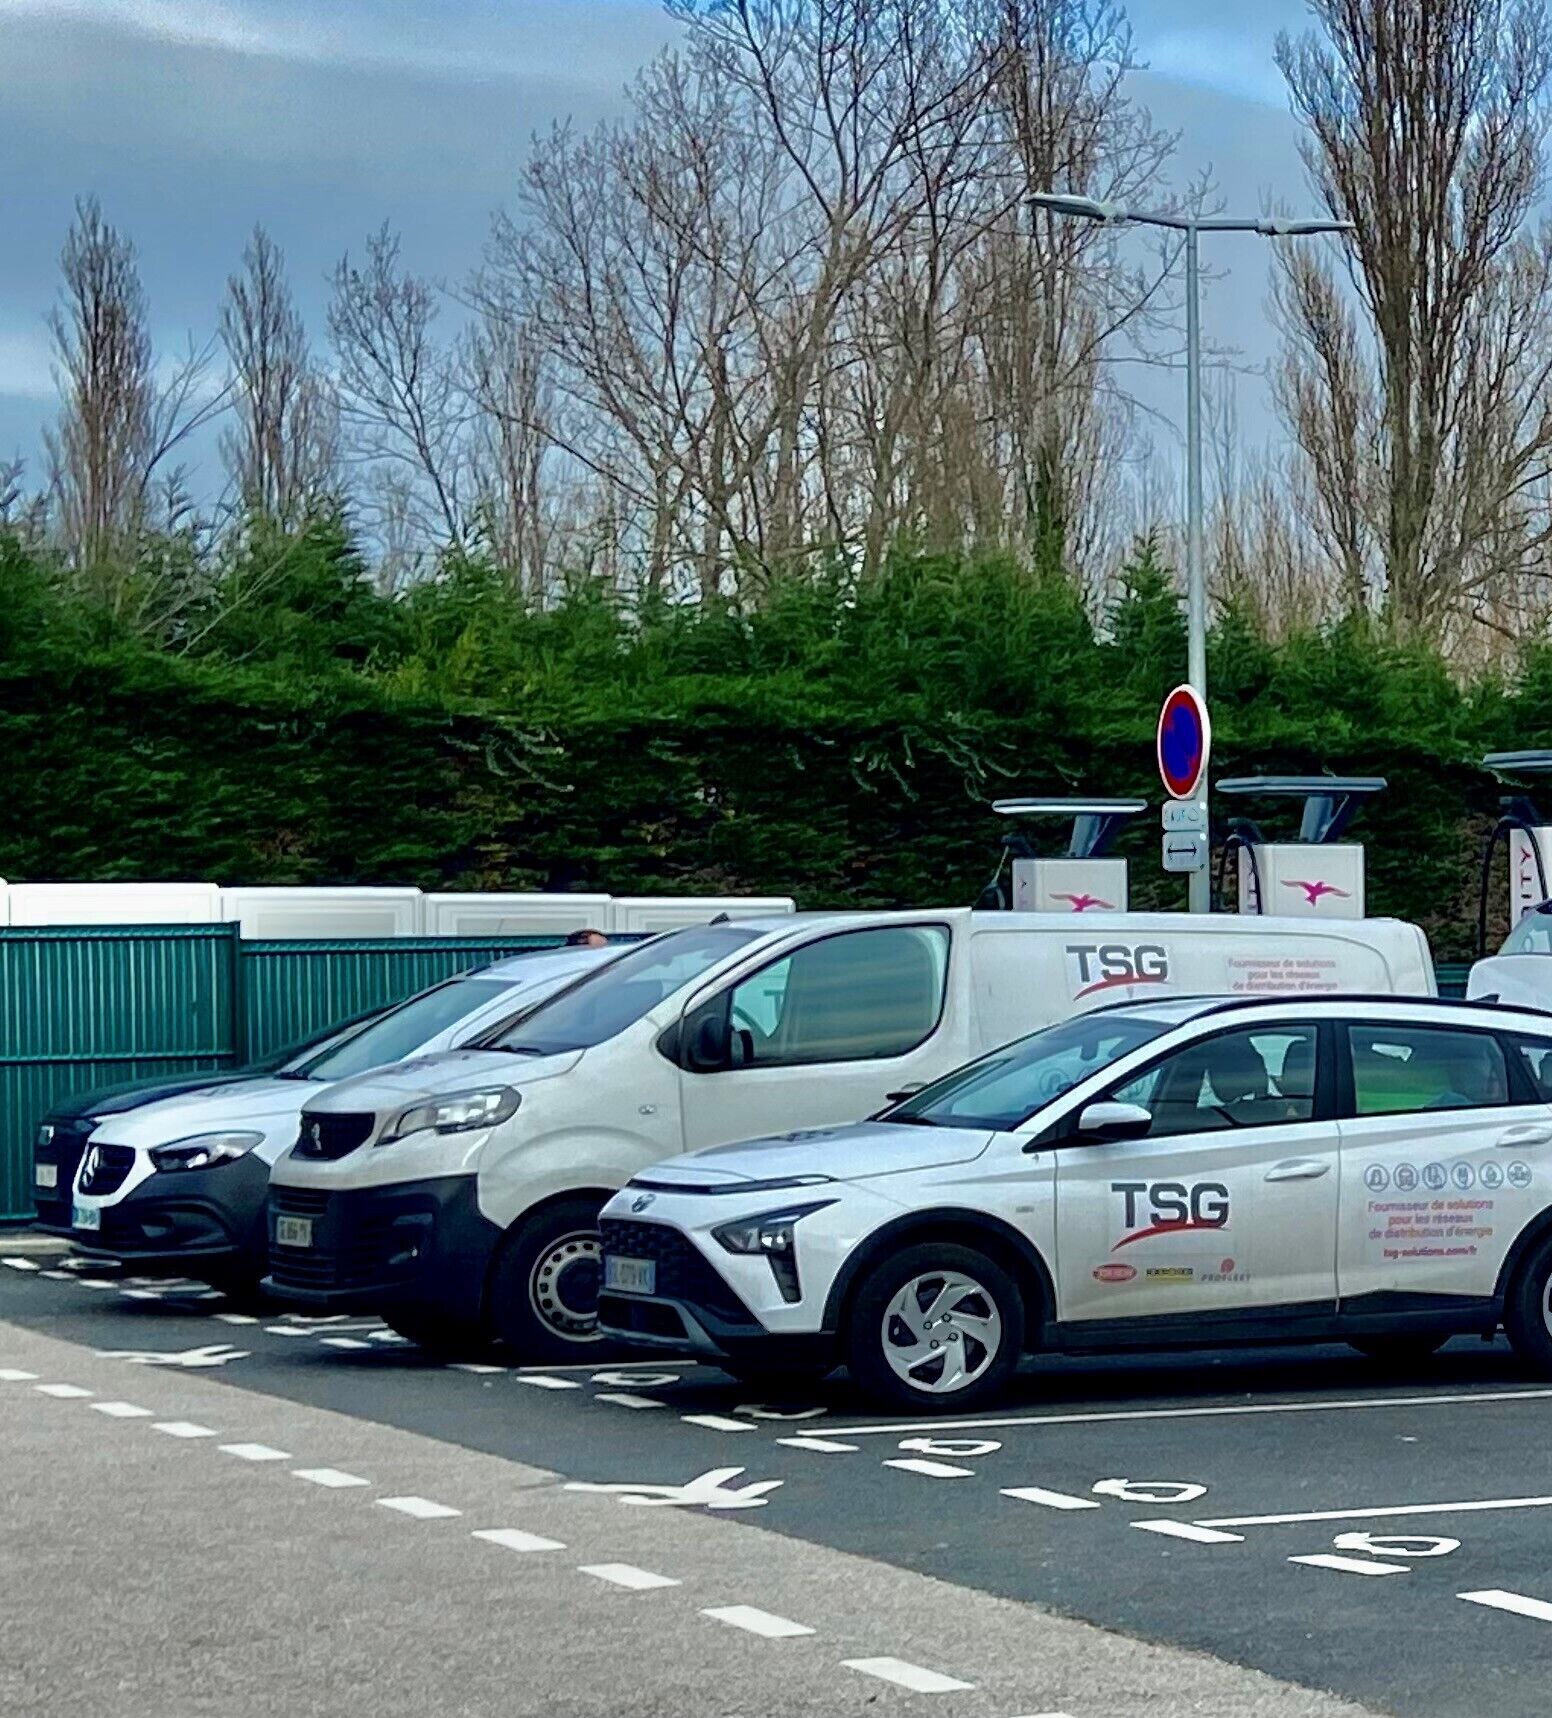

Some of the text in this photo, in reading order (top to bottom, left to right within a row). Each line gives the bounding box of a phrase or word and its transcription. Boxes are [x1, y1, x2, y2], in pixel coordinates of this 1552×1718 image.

[1066, 945, 1168, 982] TSG
[1111, 1183, 1229, 1228] TSG
[1368, 1199, 1494, 1212] Fournisseur de solutions
[1388, 1215, 1412, 1227] pour
[1415, 1213, 1429, 1225] les
[1369, 1228, 1383, 1240] de
[1384, 1227, 1444, 1238] distribution
